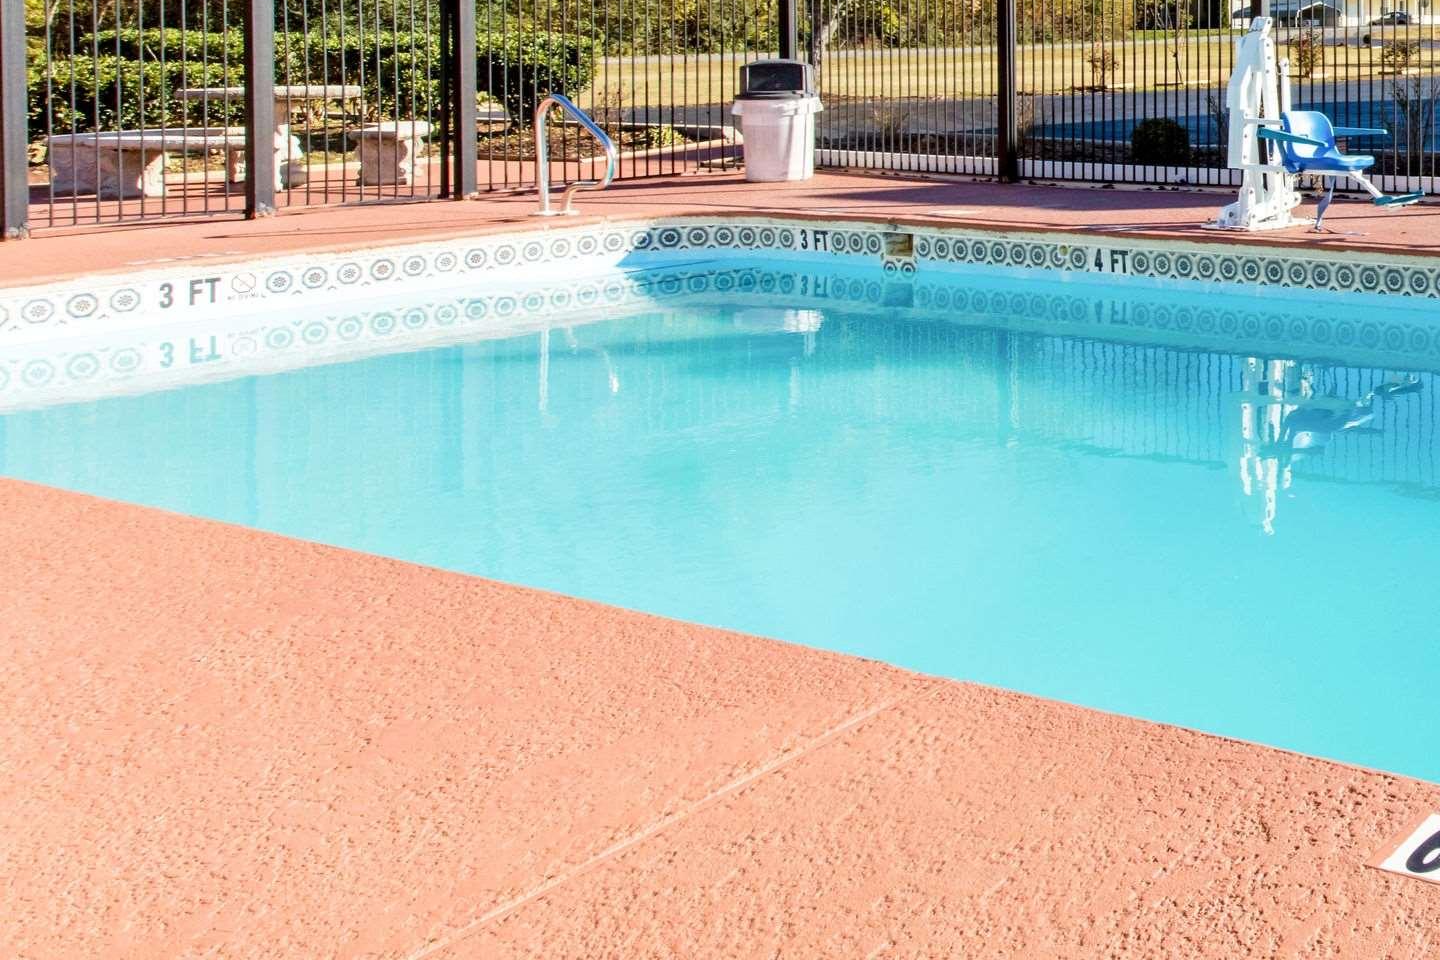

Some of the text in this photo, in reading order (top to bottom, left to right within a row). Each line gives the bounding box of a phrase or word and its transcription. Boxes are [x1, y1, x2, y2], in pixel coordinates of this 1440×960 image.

[801, 229, 828, 251] 3 FT
[1095, 248, 1128, 273] 4 FT
[159, 283, 173, 309] 3
[189, 278, 221, 306] FT
